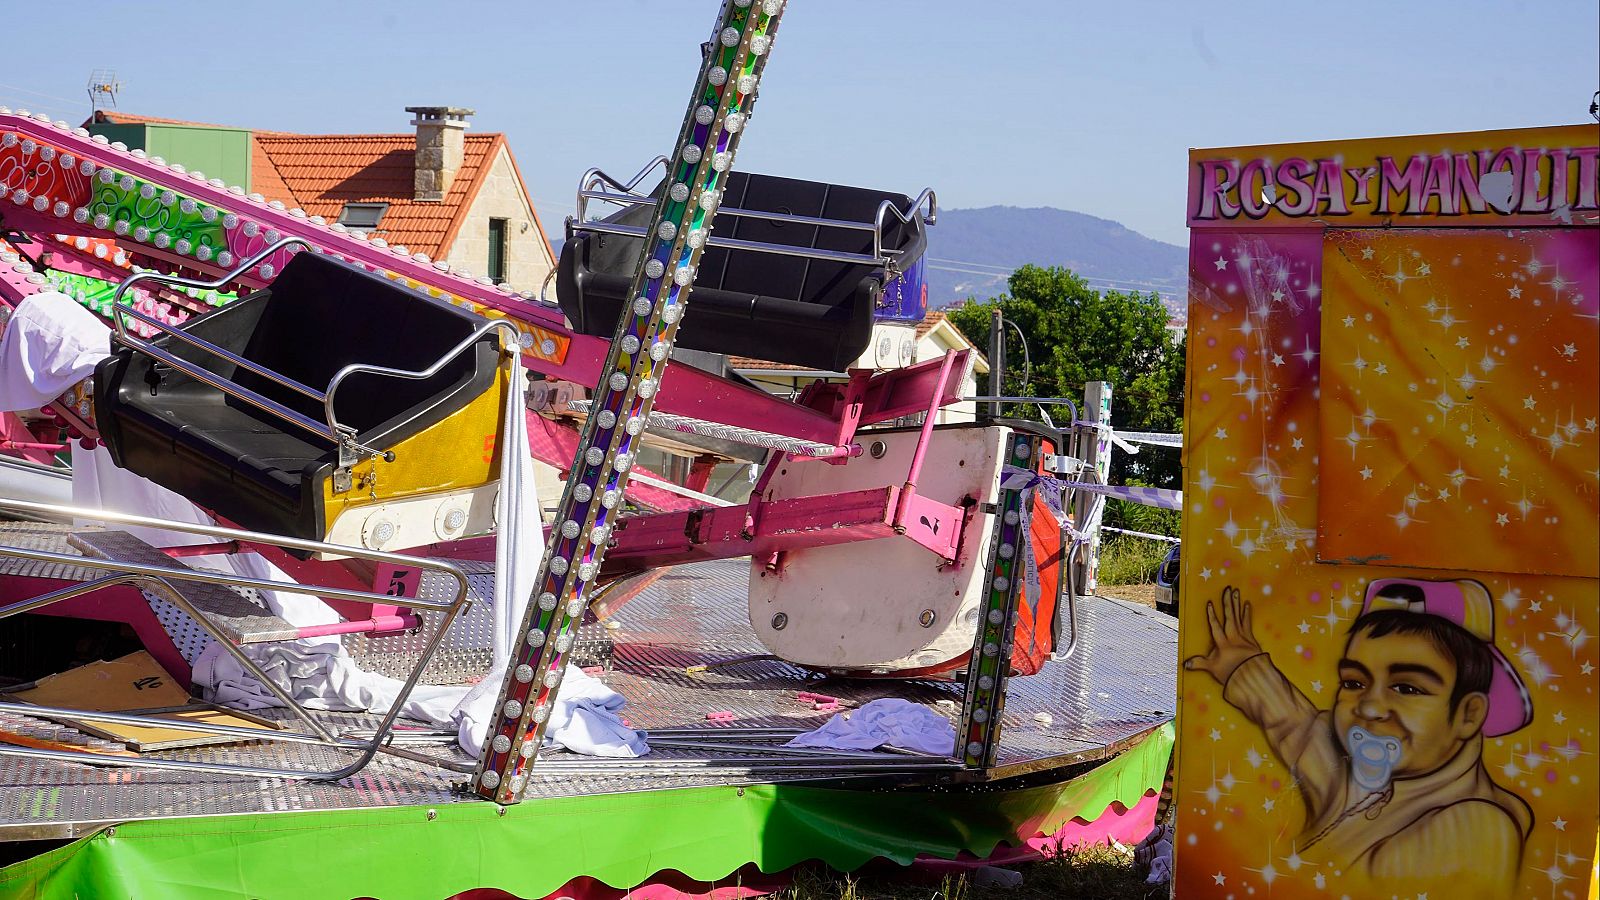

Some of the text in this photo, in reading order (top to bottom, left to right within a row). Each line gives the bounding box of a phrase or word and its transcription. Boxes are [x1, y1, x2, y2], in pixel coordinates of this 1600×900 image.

[1193, 157, 1352, 220] ROSA
[1344, 166, 1377, 205] Y
[921, 283, 927, 309] 6
[482, 433, 497, 464] 5
[386, 570, 409, 597] 5
